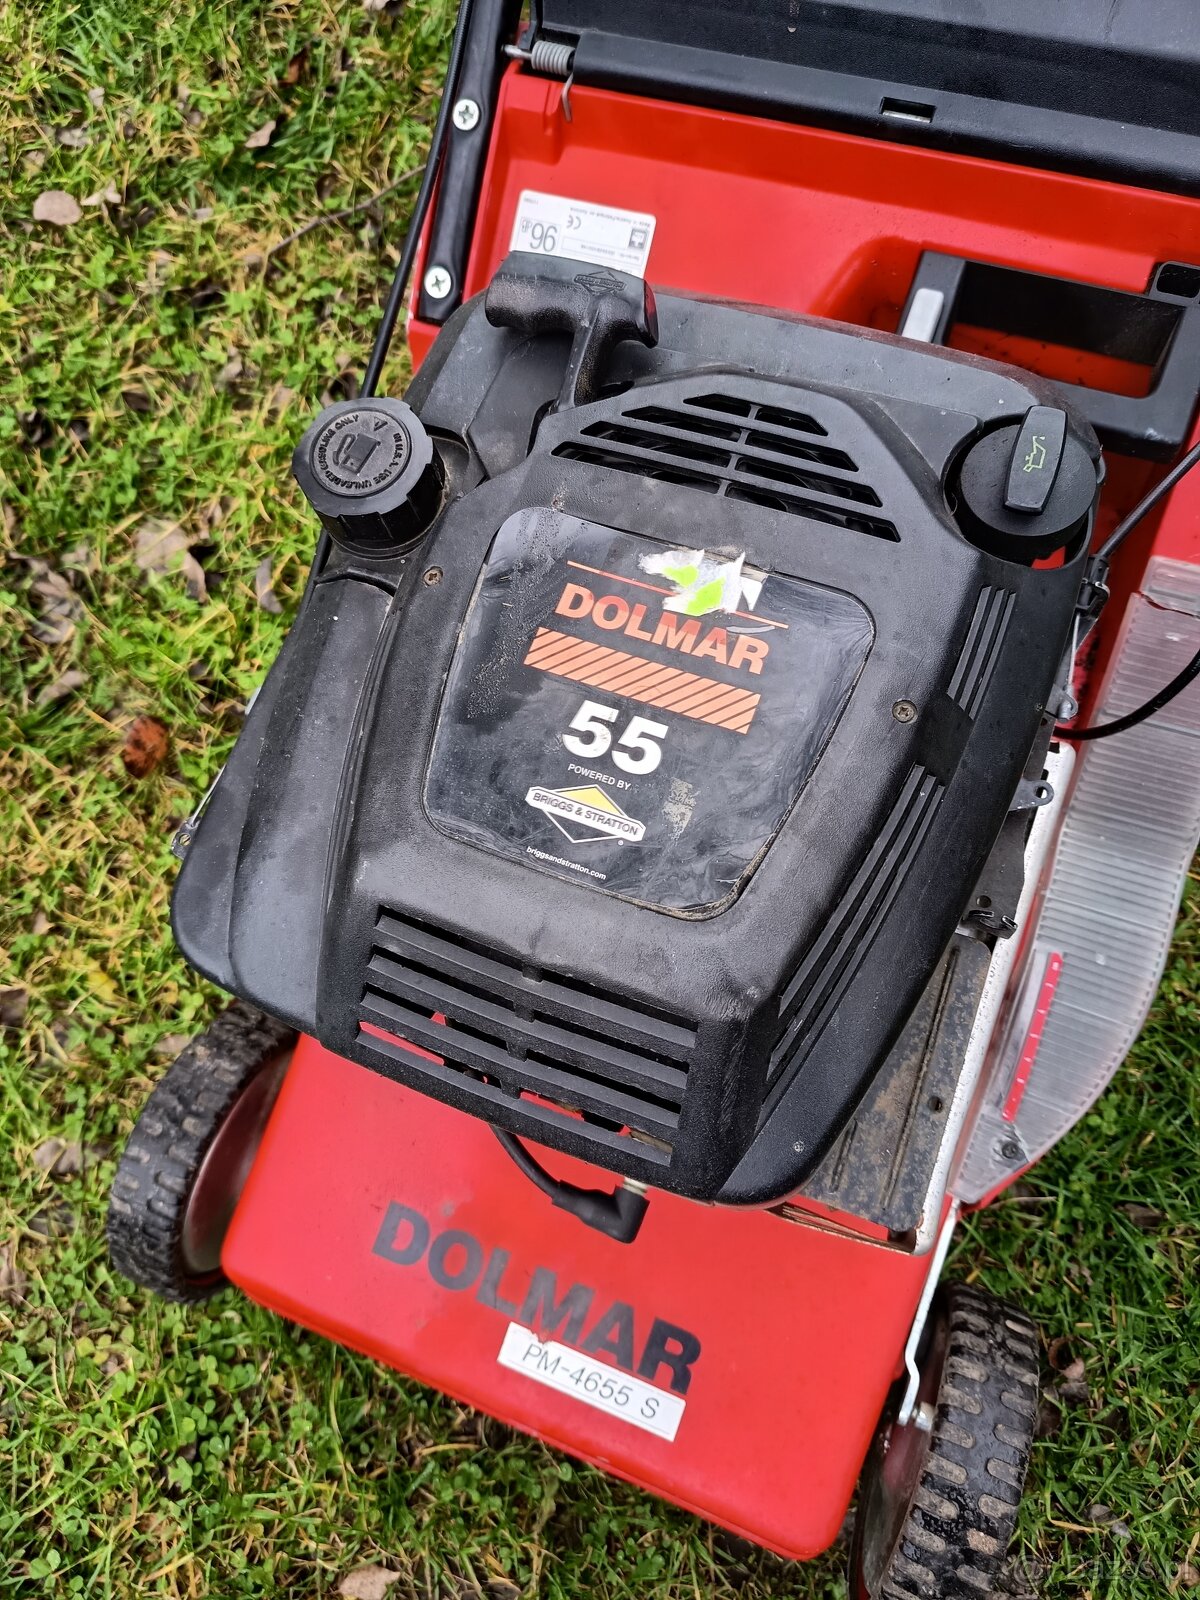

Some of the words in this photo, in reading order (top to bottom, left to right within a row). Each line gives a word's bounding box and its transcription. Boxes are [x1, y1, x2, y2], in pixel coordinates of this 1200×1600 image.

[530, 222, 557, 252] 96
[334, 414, 359, 429] ONLY
[317, 428, 337, 470] GASOLINE
[325, 470, 373, 489] UNLEADED
[373, 468, 392, 485] USE
[554, 582, 769, 675] DOLMAR
[562, 700, 669, 775] 55
[567, 763, 616, 785] POWERED
[616, 779, 632, 791] BY
[532, 792, 574, 813] BRIGGS
[575, 806, 584, 817] &
[583, 809, 639, 836] STRATTON
[526, 846, 607, 880] briggsandstratton.com
[371, 1200, 702, 1396] DOLMAR
[521, 1343, 634, 1408] PM-4655
[639, 1396, 661, 1420] S
